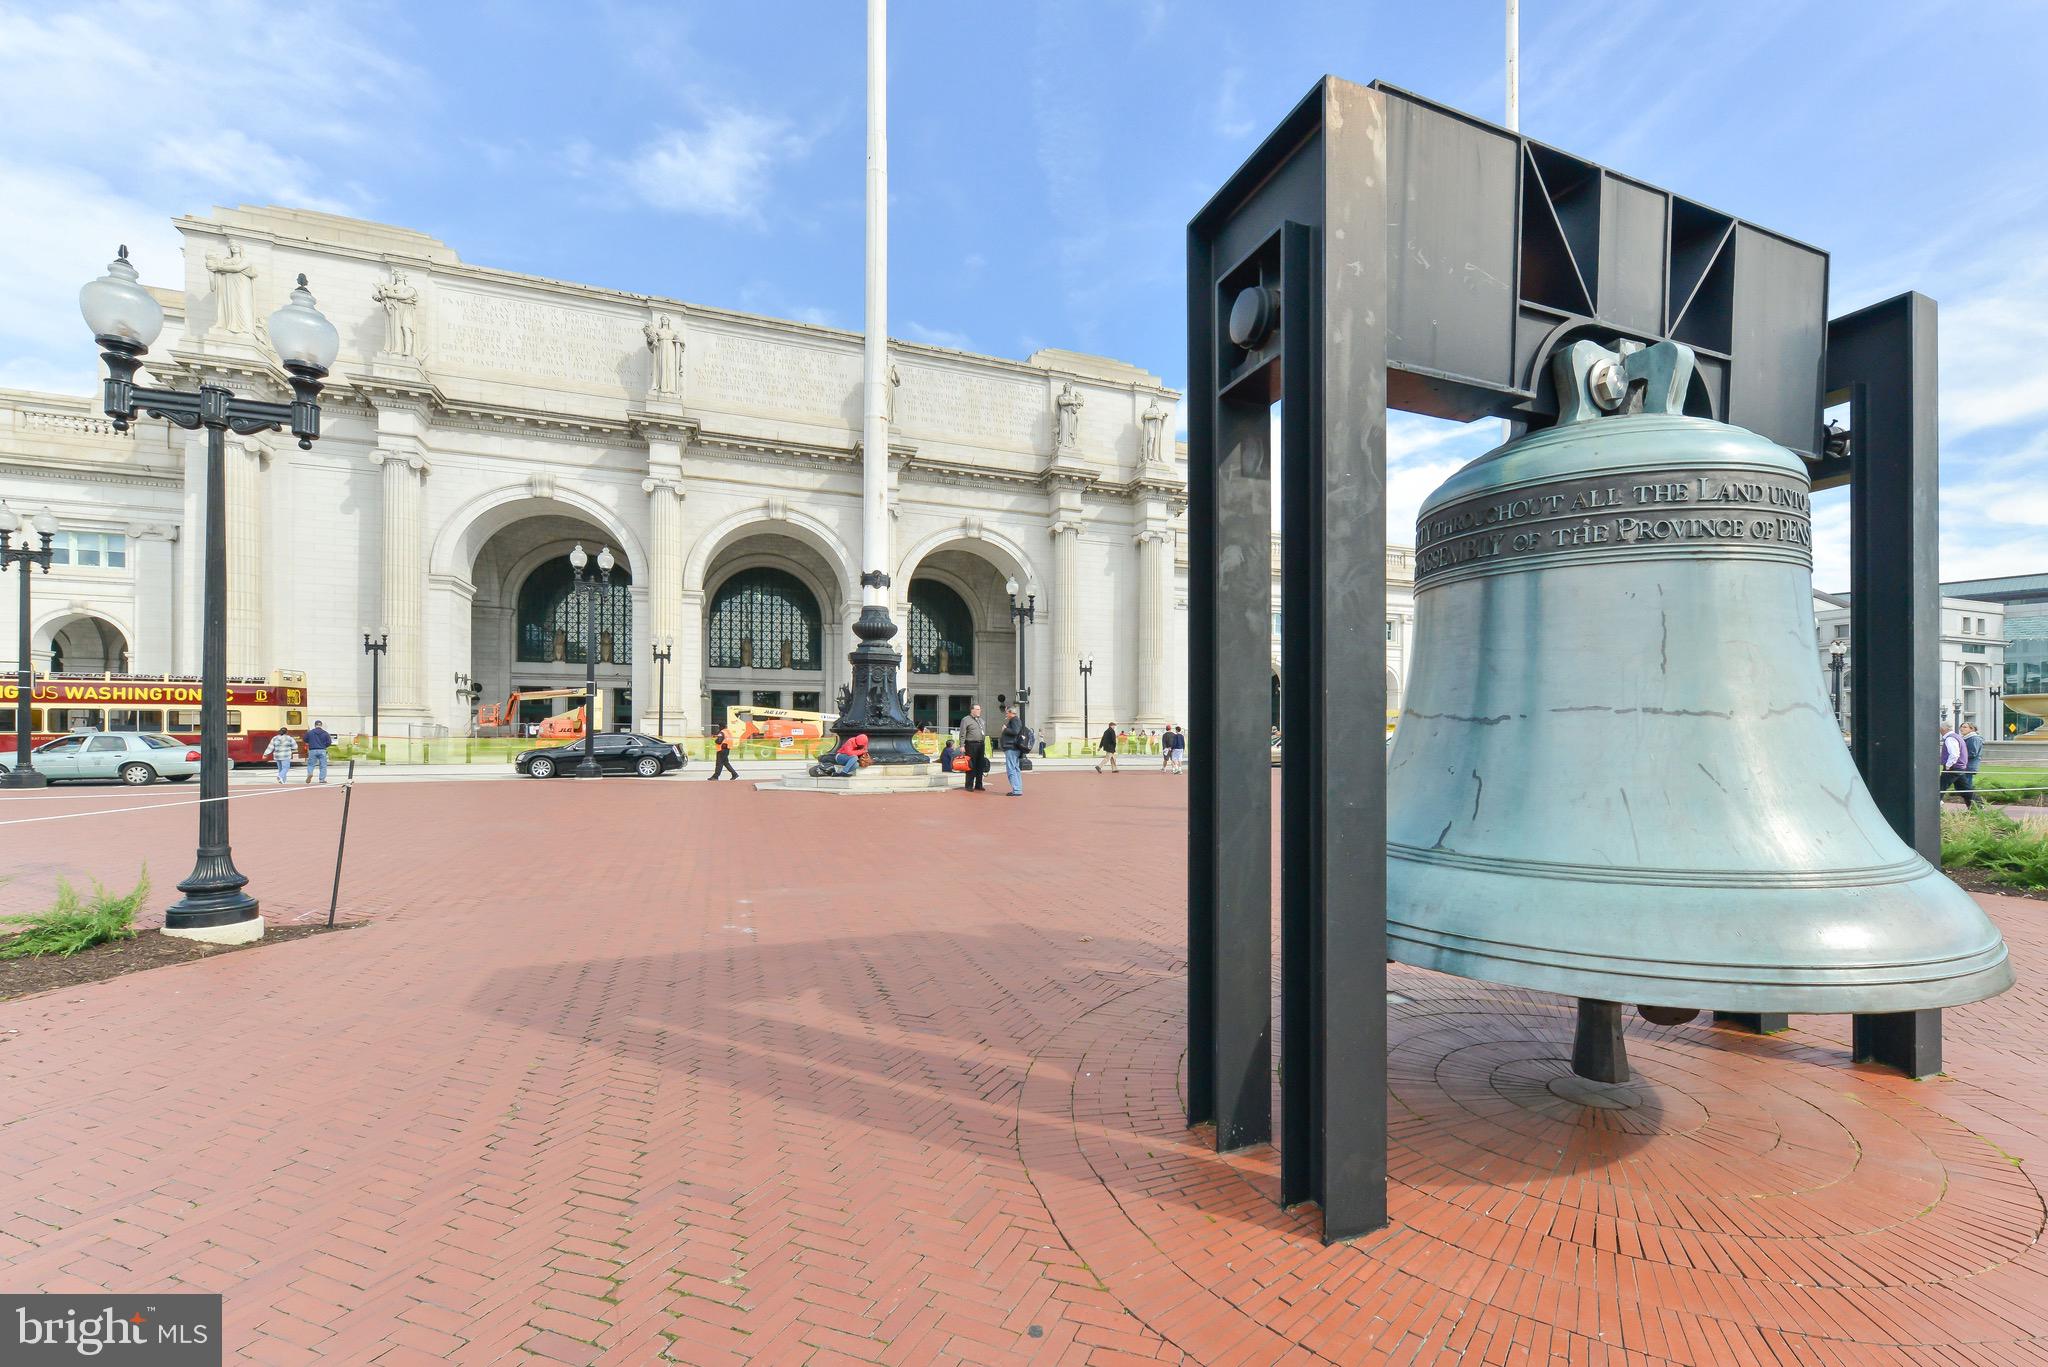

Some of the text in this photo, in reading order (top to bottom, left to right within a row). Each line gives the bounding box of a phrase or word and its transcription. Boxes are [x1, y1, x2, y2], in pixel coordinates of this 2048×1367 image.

[1435, 494, 1565, 538] THROUGHOUT
[1571, 488, 1622, 512] ALL
[1633, 483, 1689, 504] THE
[1698, 477, 1763, 502] LAND
[1768, 485, 1806, 511] UNTO
[1420, 533, 1504, 574] ASSEMBLY
[1513, 532, 1541, 552] OF
[1551, 522, 1609, 547] THE
[1616, 517, 1744, 541] PROVINCE
[1751, 519, 1774, 539] OF
[0, 685, 18, 699] IG
[32, 686, 58, 699] US
[65, 686, 202, 701] WASHINGTON
